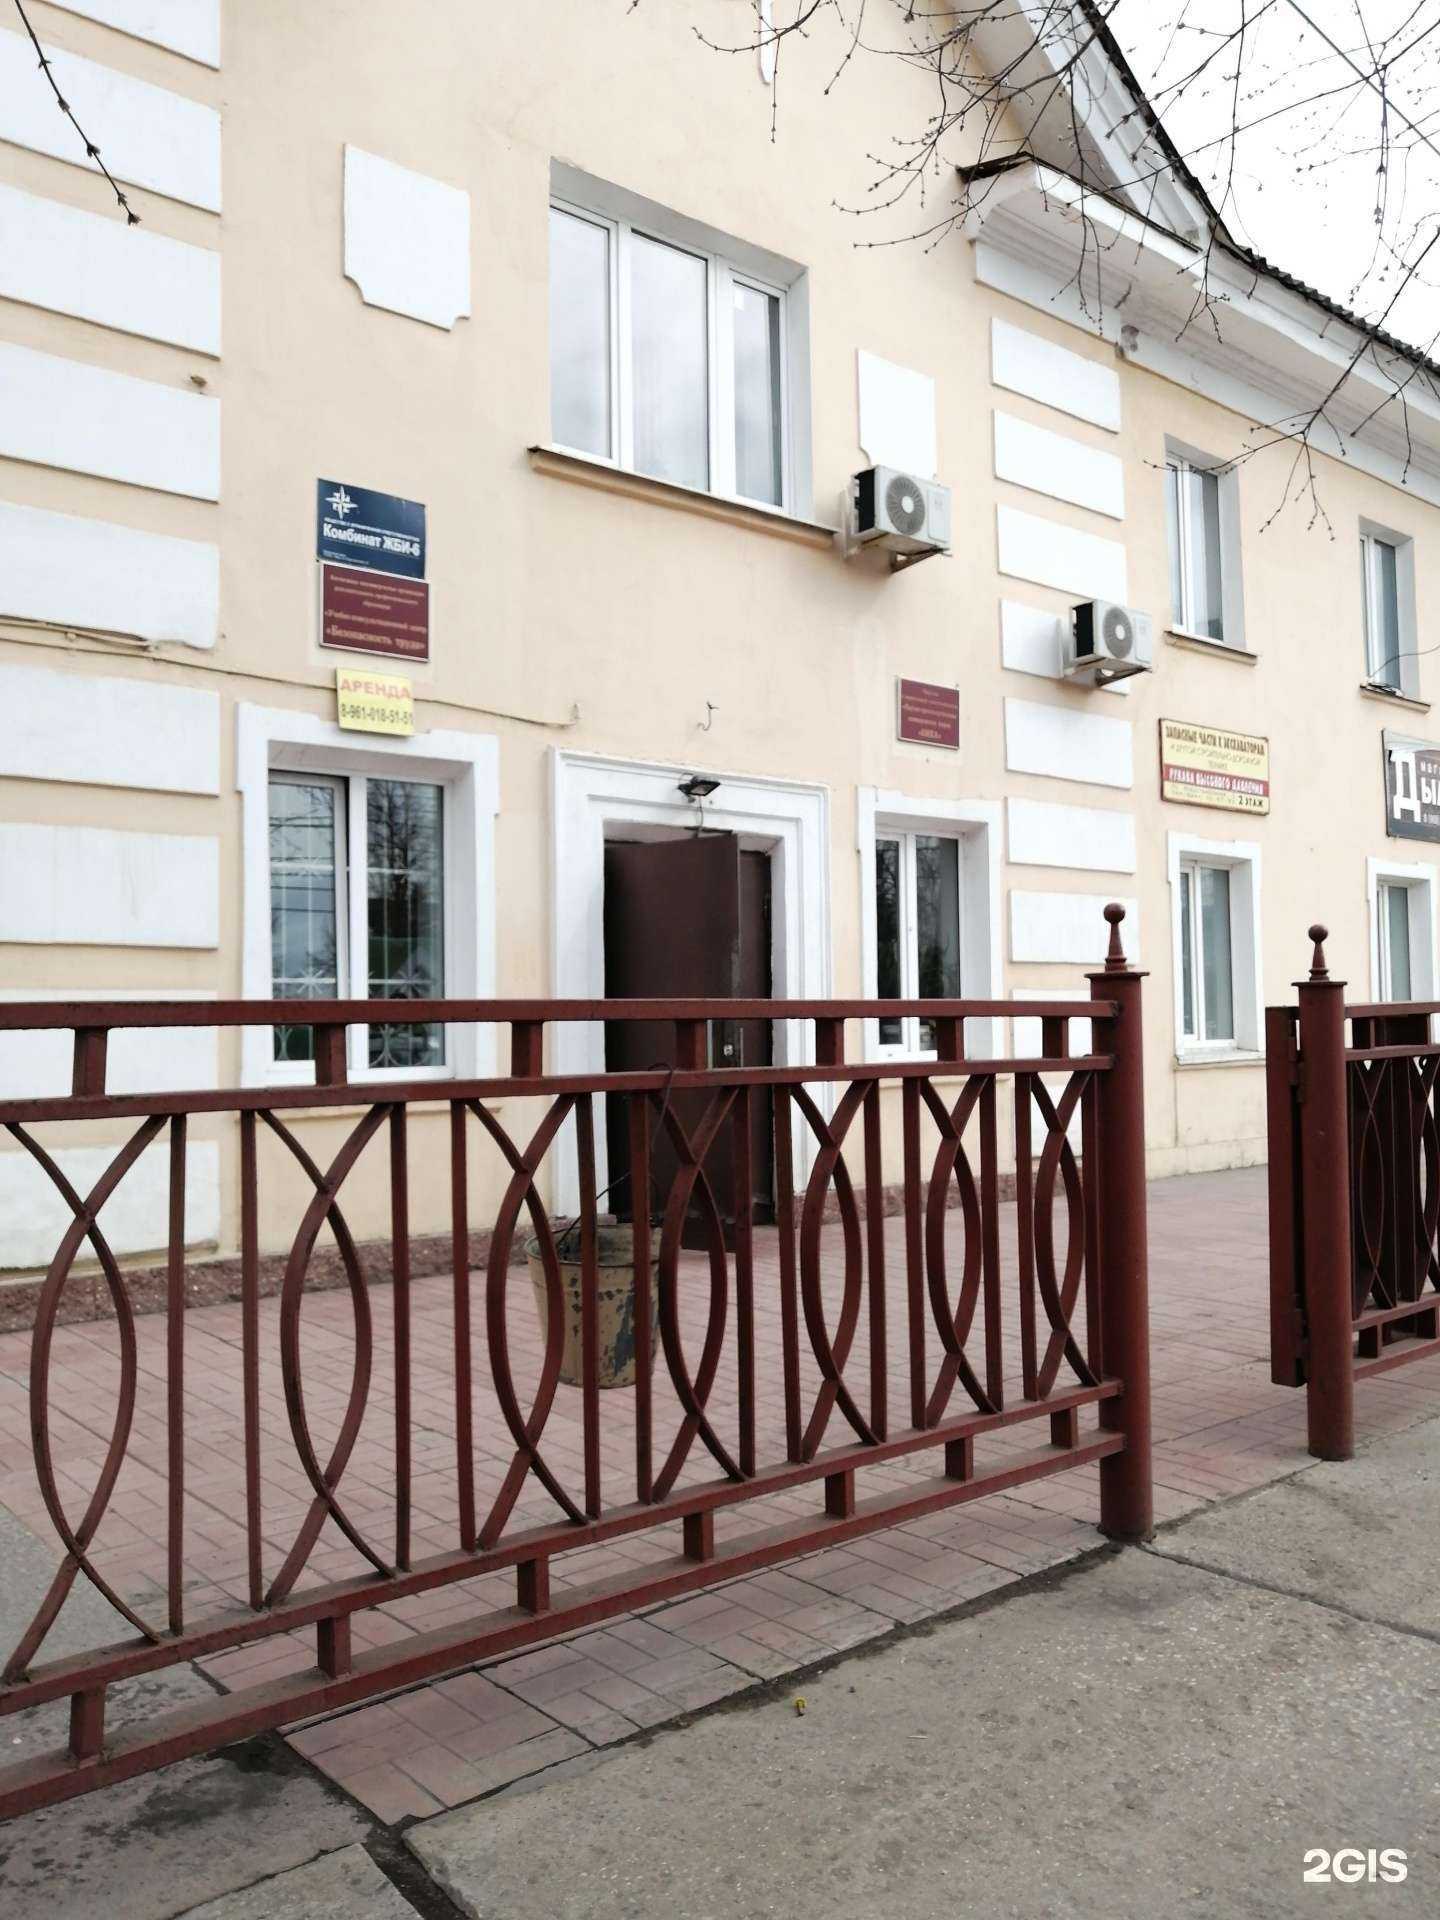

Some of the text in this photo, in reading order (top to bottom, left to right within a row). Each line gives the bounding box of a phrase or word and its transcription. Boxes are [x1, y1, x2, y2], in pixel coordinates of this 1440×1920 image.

[323, 523, 381, 548] Комбинат
[383, 535, 420, 557] ЖБИ-6
[341, 678, 412, 699] АРЕНДА
